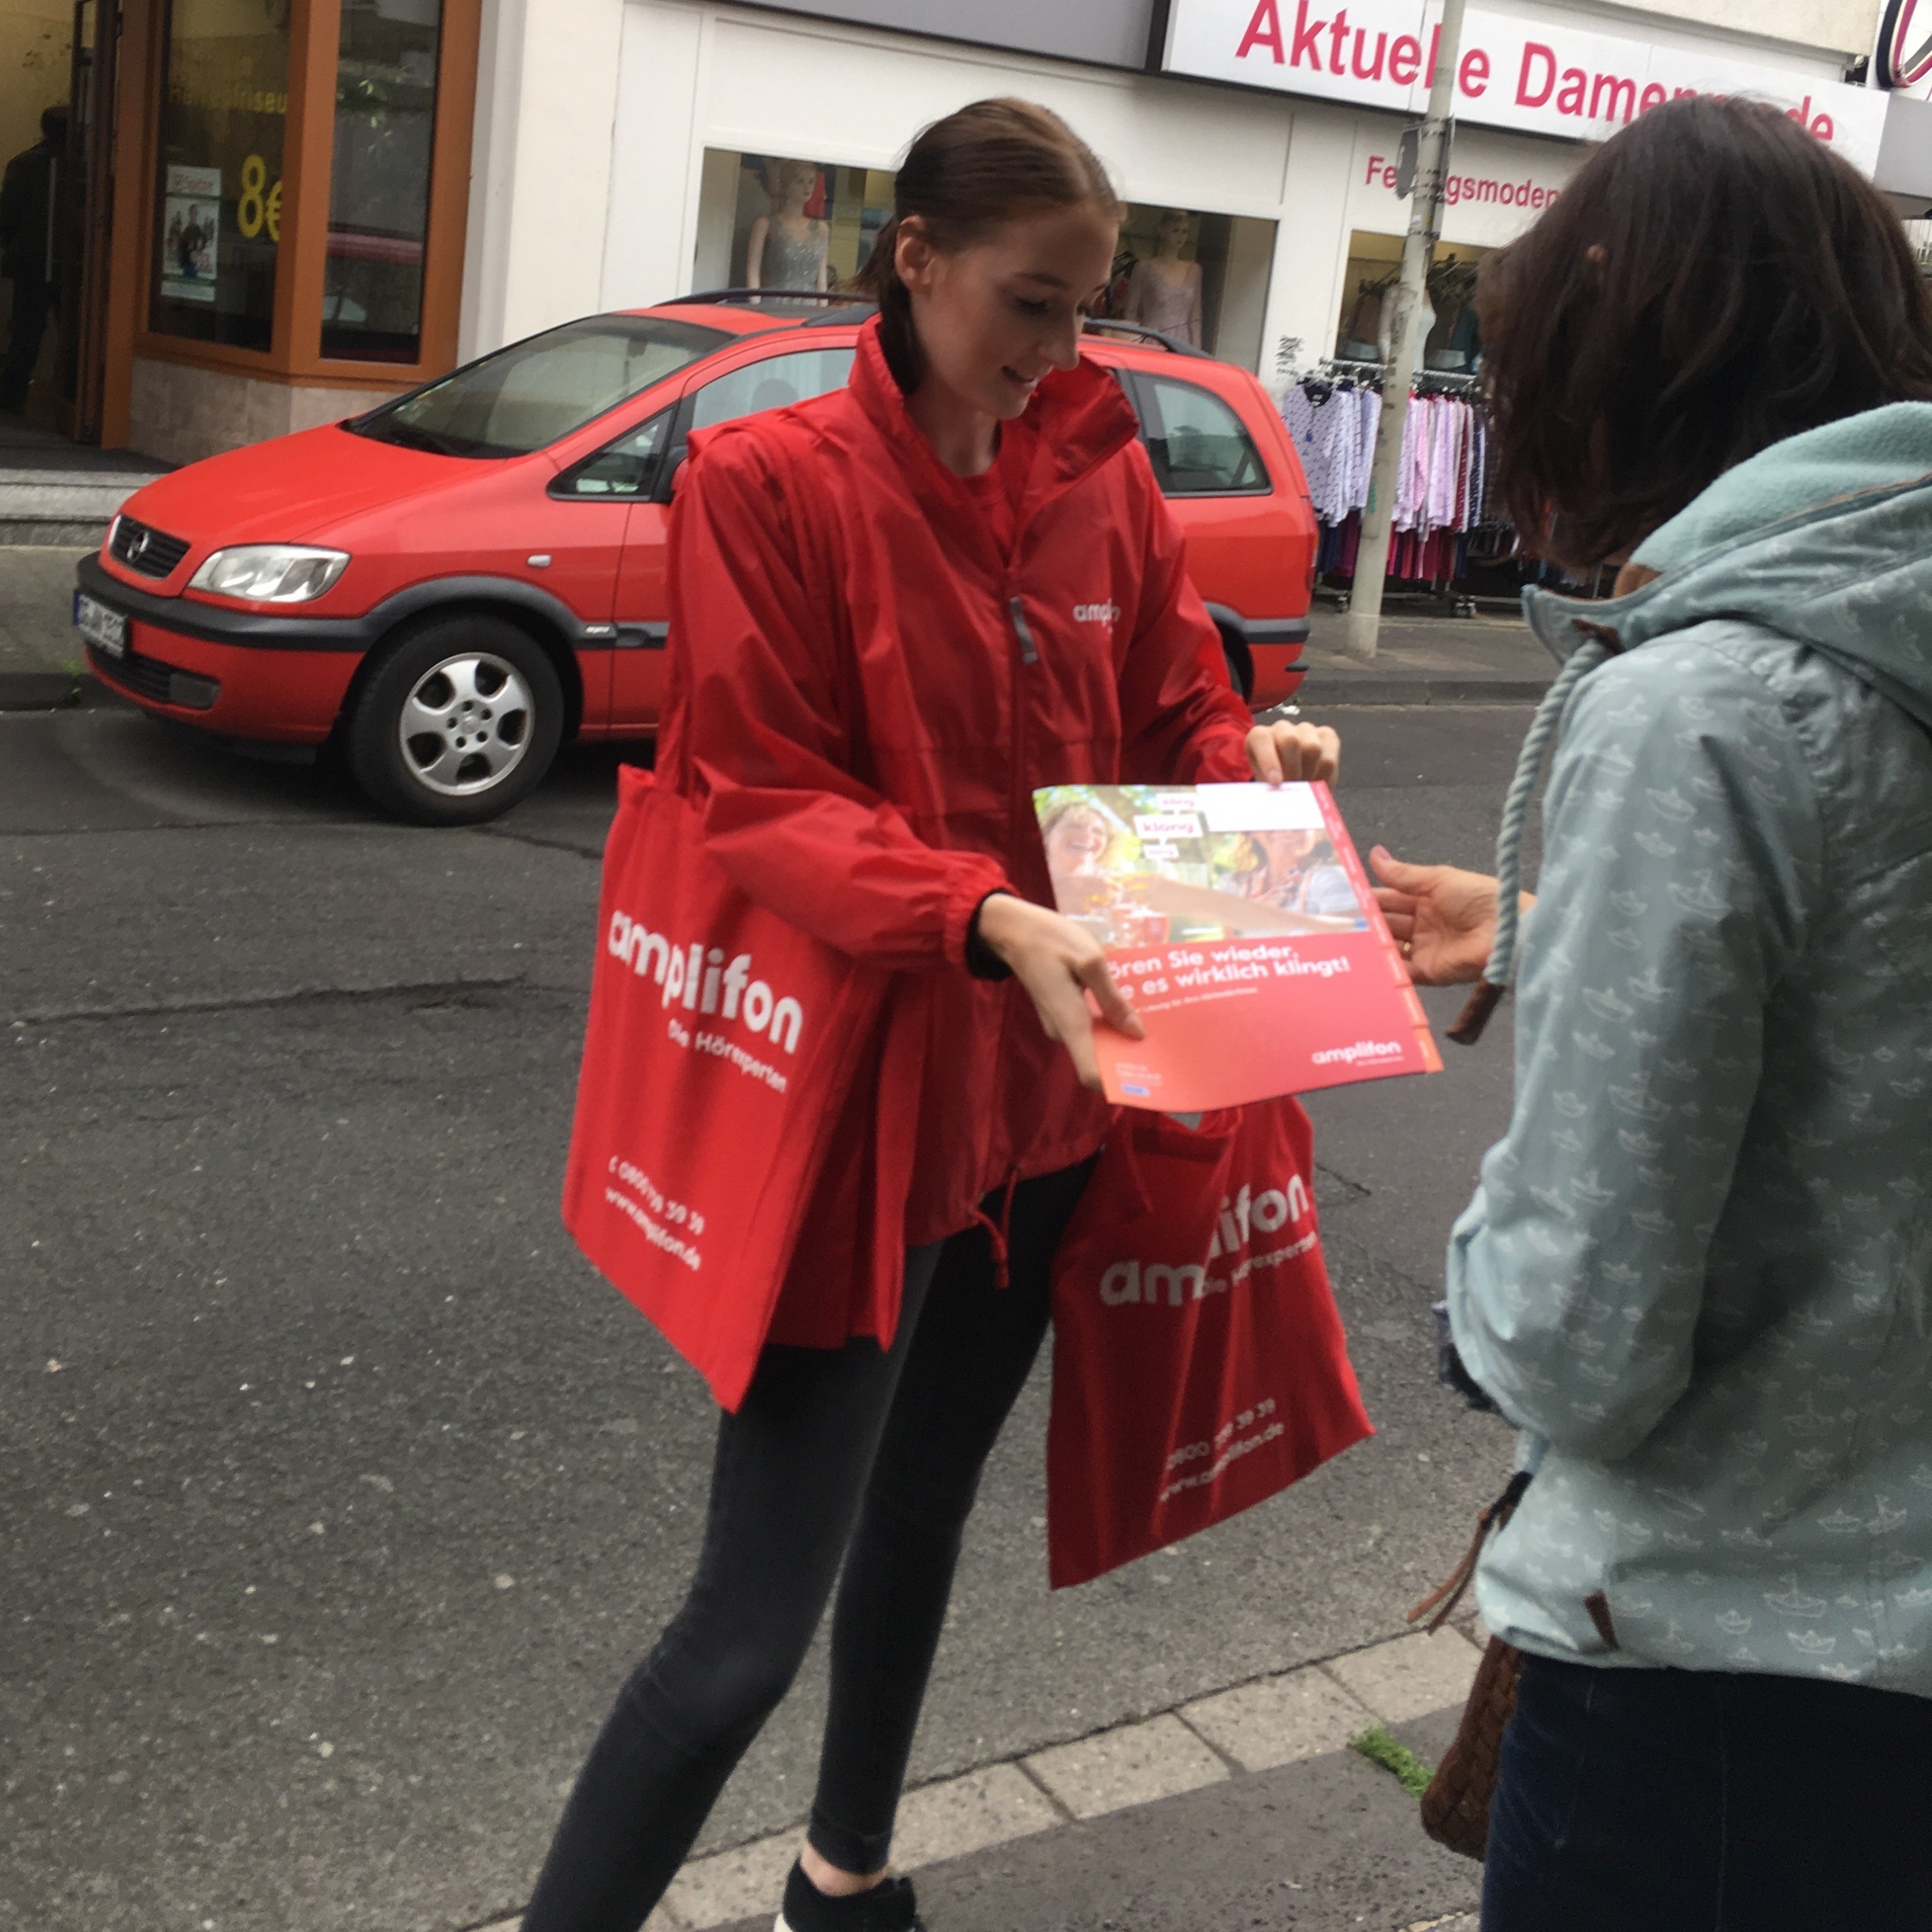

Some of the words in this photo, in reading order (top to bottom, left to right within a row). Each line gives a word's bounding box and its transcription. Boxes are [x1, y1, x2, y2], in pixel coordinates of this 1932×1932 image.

[1234, 0, 1491, 99] Aktuele
[608, 910, 803, 1054] amplifon
[1106, 955, 1162, 980] ören
[1167, 950, 1204, 969] Sie
[1142, 977, 1169, 996] es
[1175, 961, 1269, 987] wirklich
[1273, 956, 1350, 978] klingt!
[1312, 1040, 1402, 1065] amplifon
